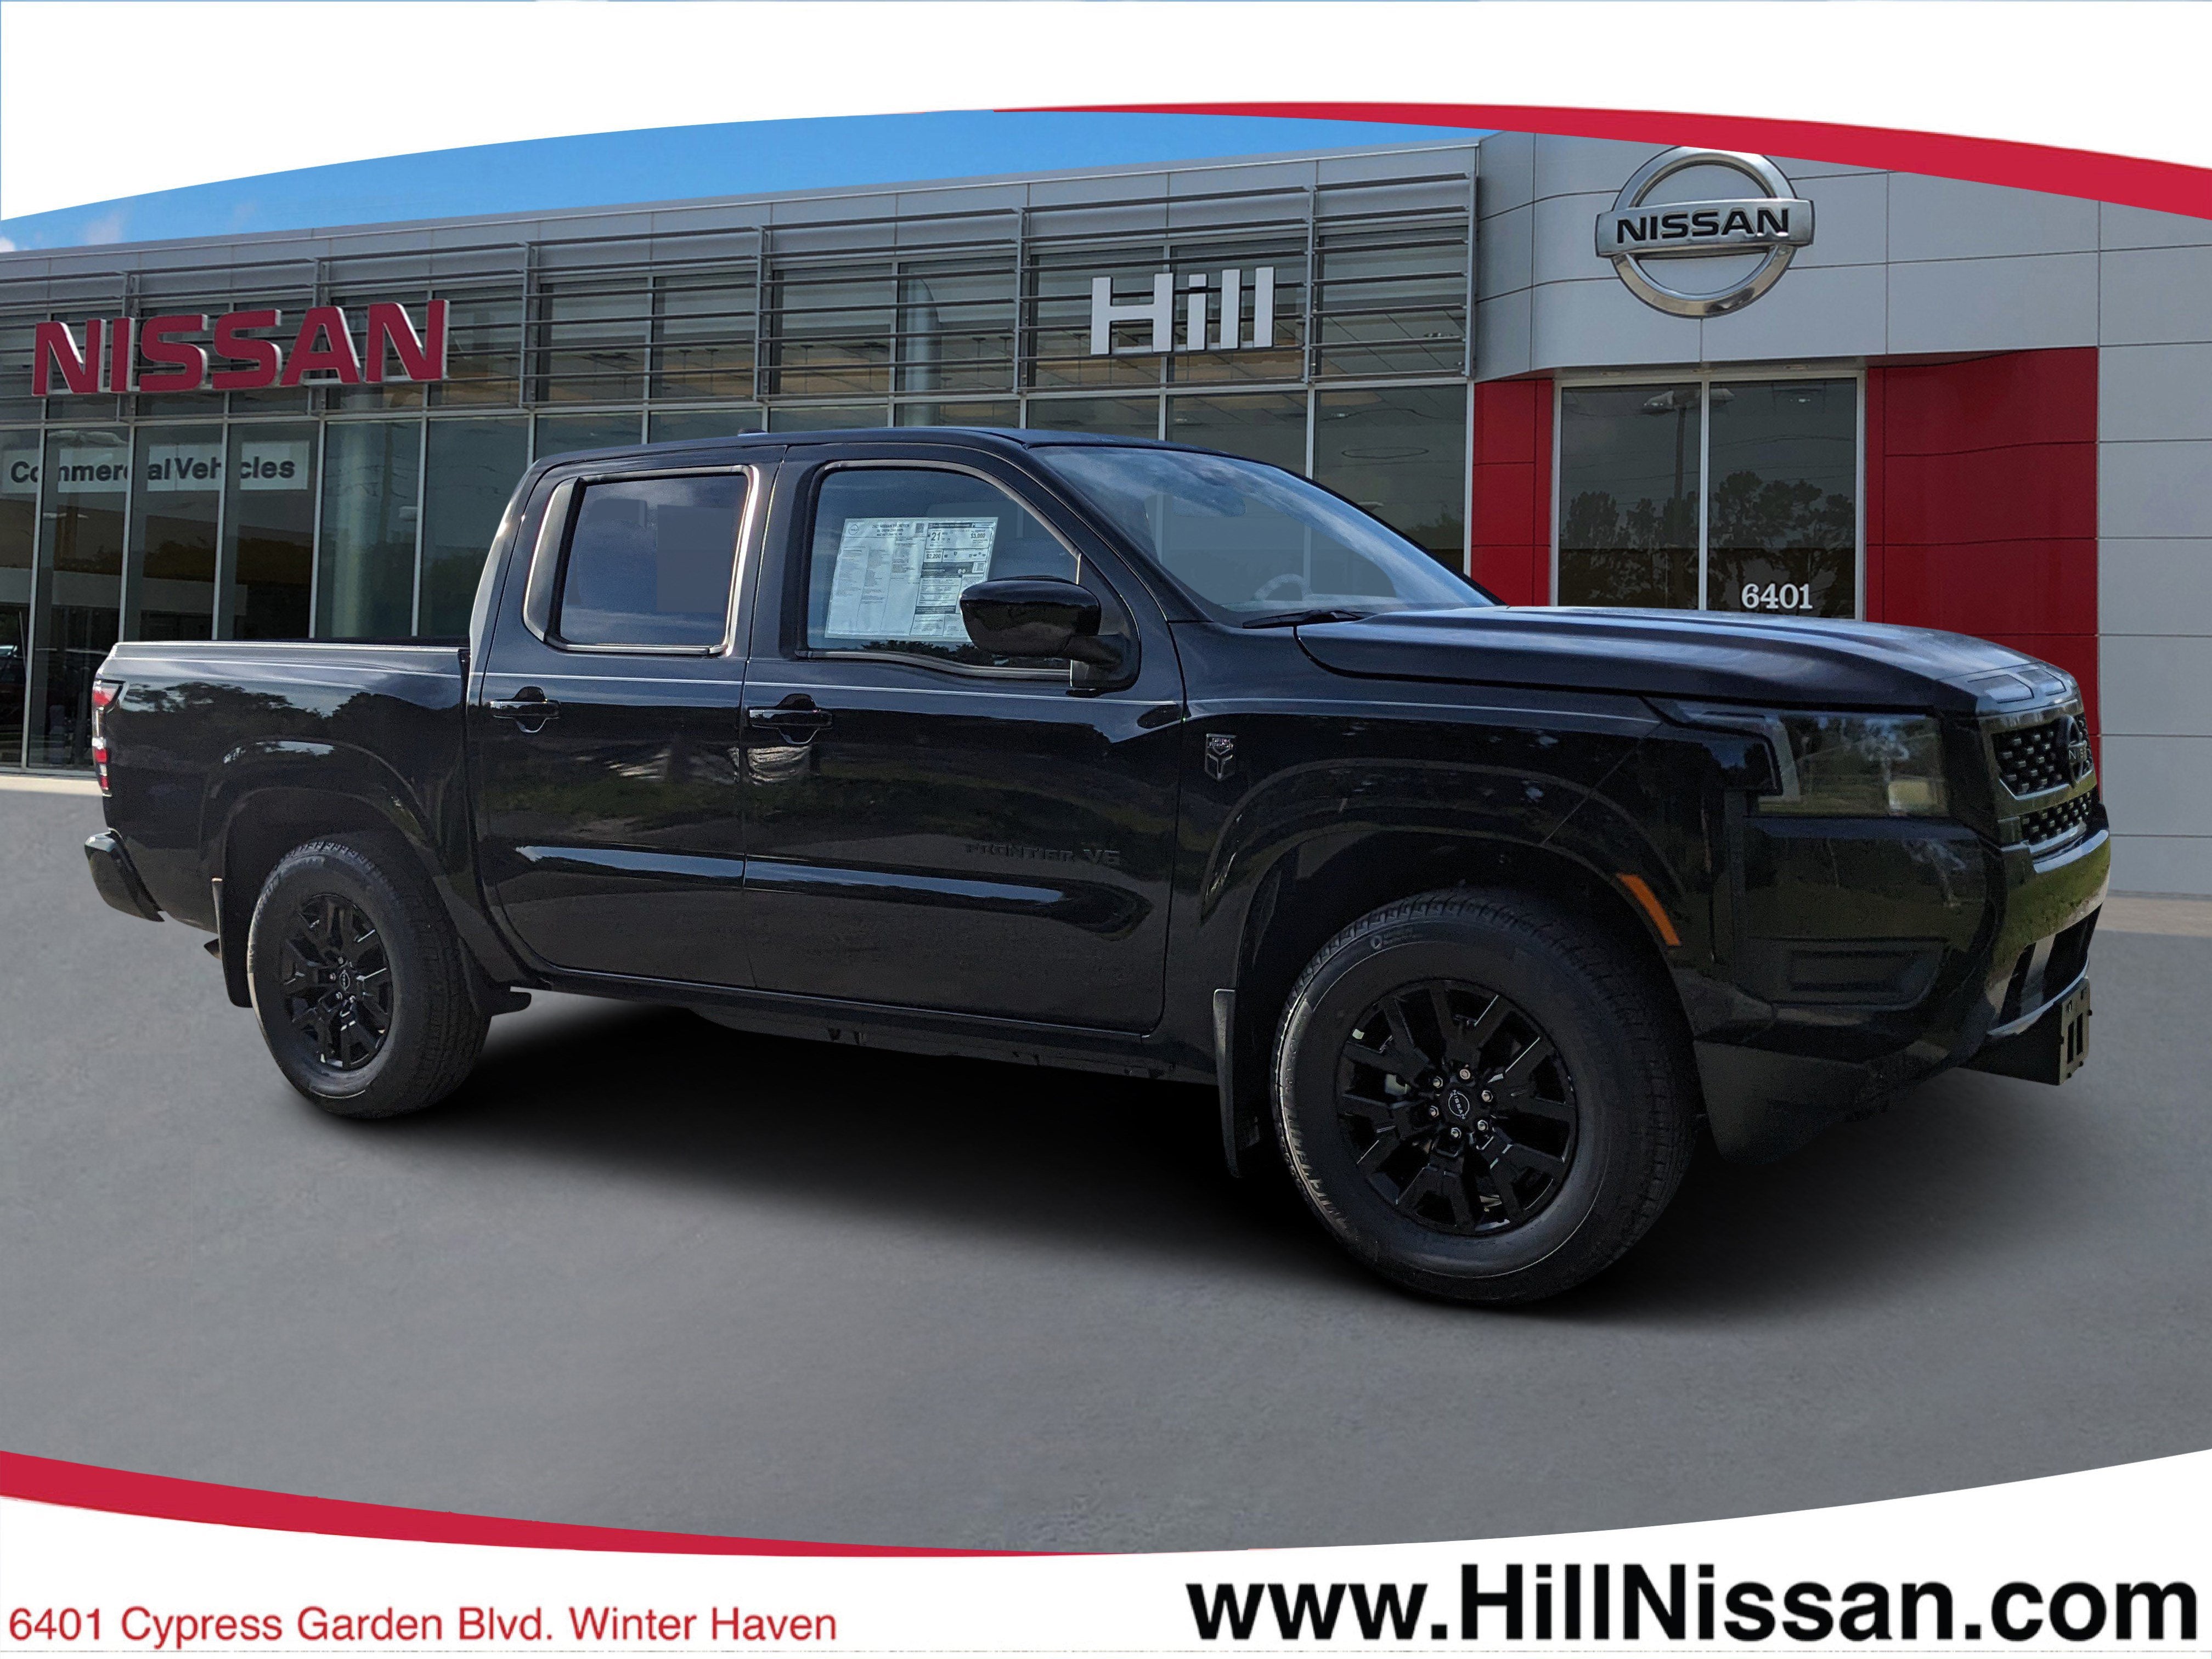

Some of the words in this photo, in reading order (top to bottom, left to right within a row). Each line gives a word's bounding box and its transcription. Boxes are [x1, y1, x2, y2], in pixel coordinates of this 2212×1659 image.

[1617, 207, 1789, 244] NISSAN
[1090, 266, 1274, 355] Hill
[31, 300, 450, 396] NISSAN
[174, 456, 295, 479] Vehcles
[1741, 583, 1813, 609] 6401
[1452, 1090, 1466, 1120] NISSAN
